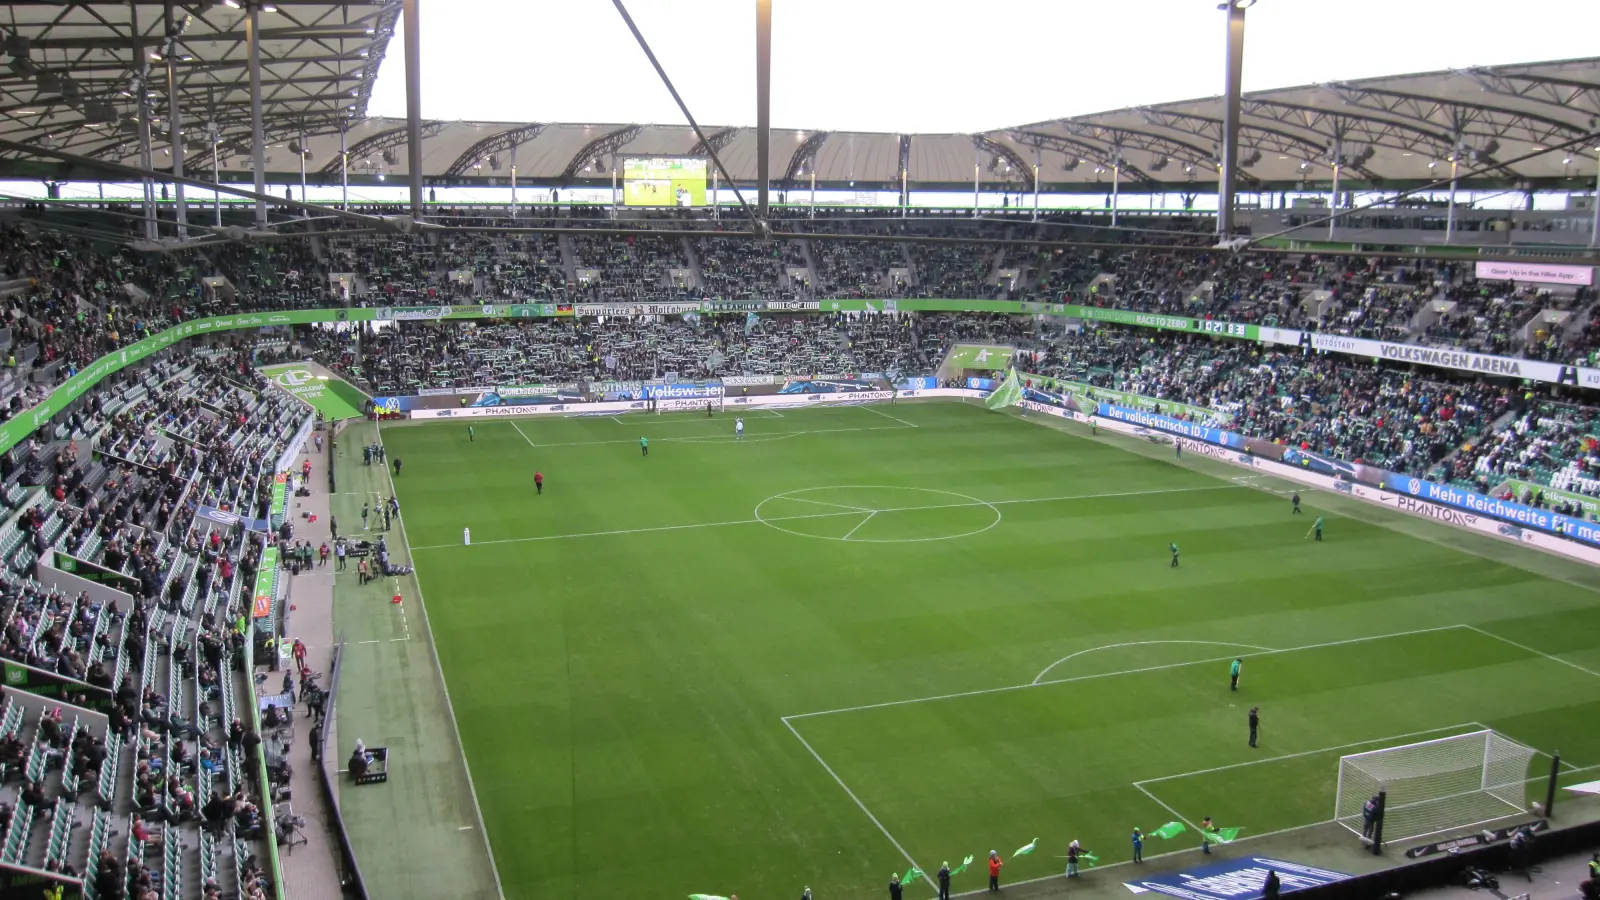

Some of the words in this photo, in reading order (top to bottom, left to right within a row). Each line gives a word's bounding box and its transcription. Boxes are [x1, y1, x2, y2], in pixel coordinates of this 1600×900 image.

[577, 304, 630, 316] Supporters
[648, 304, 697, 315] Wolfsburg
[1136, 315, 1155, 326] RACE
[1156, 317, 1167, 327] TO
[1167, 319, 1187, 329] ZERO
[1315, 338, 1355, 349] AUTOSTADT
[1380, 343, 1470, 369] VOLKSWAGEN
[1472, 356, 1520, 376] ARENA
[849, 391, 888, 399] PHANTOM
[485, 406, 533, 415] PHANTOM
[1109, 406, 1124, 418] Der
[1191, 427, 1209, 440] ID.7
[1398, 496, 1470, 526] PHANTOM
[1429, 483, 1463, 505] Mehr
[1465, 491, 1548, 527] Reichweite
